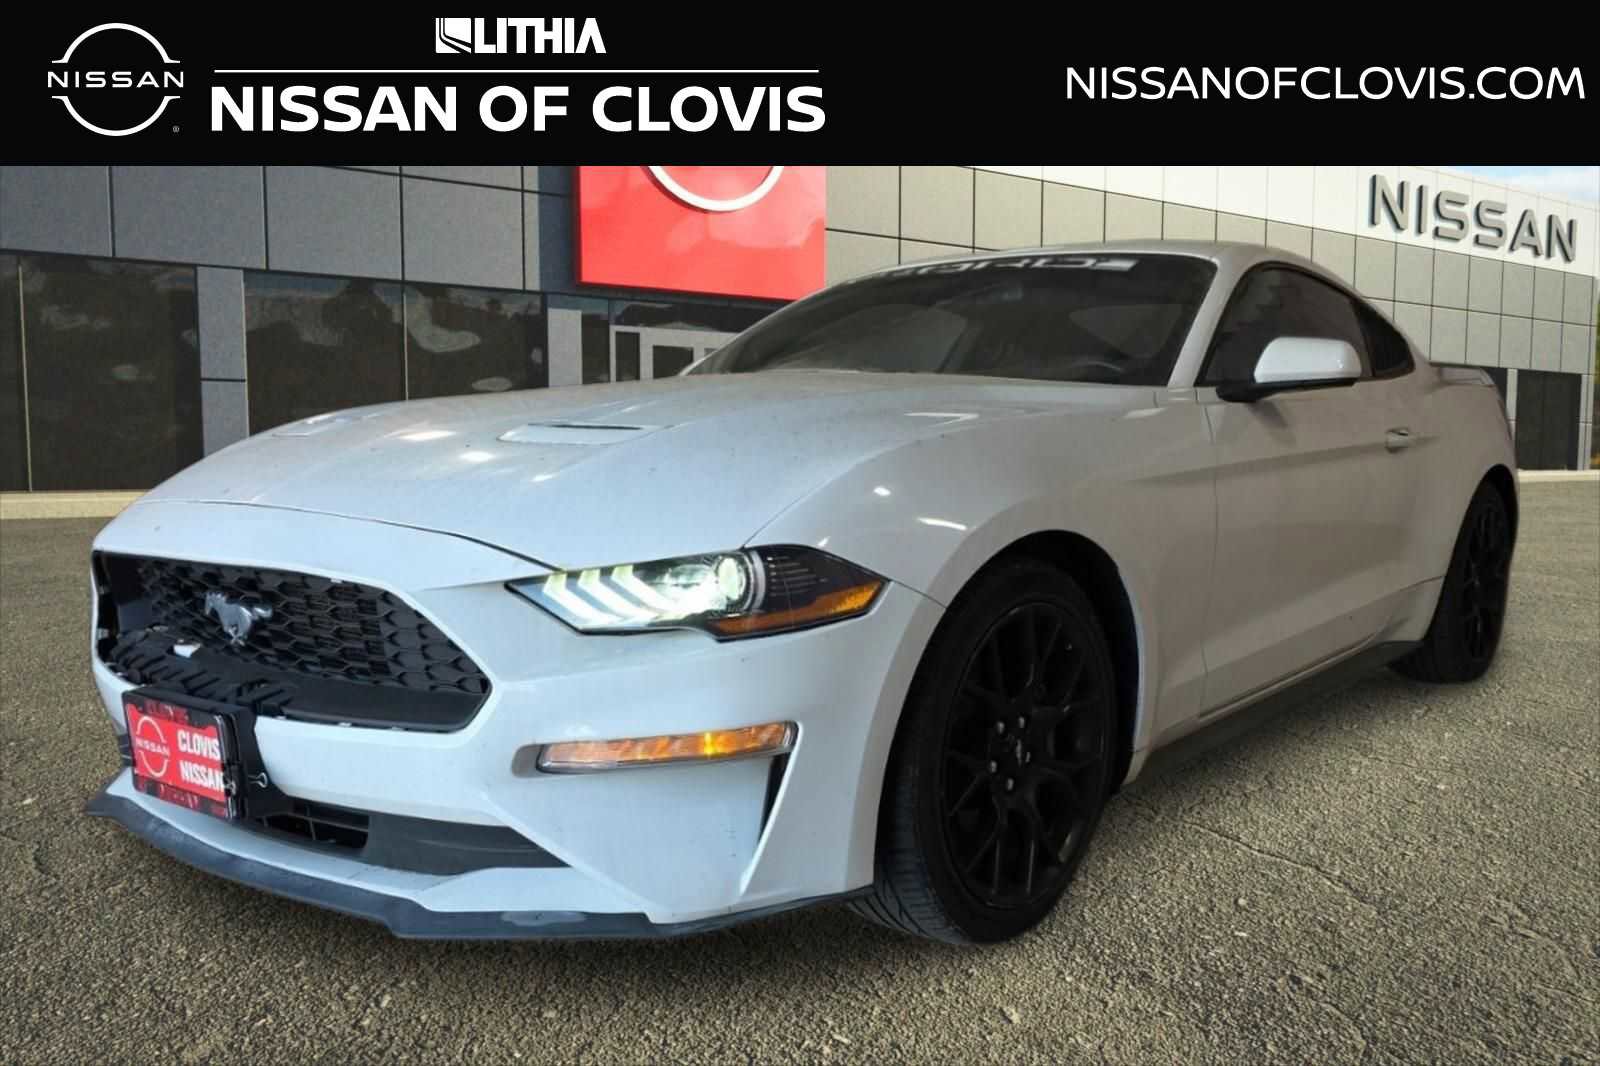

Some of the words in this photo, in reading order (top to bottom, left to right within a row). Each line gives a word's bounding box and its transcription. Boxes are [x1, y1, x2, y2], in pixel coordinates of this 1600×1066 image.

[1369, 174, 1577, 262] NISSAN
[134, 736, 170, 758] NISSAN
[176, 729, 221, 761] CLOVIS
[179, 759, 225, 793] NISSAN
